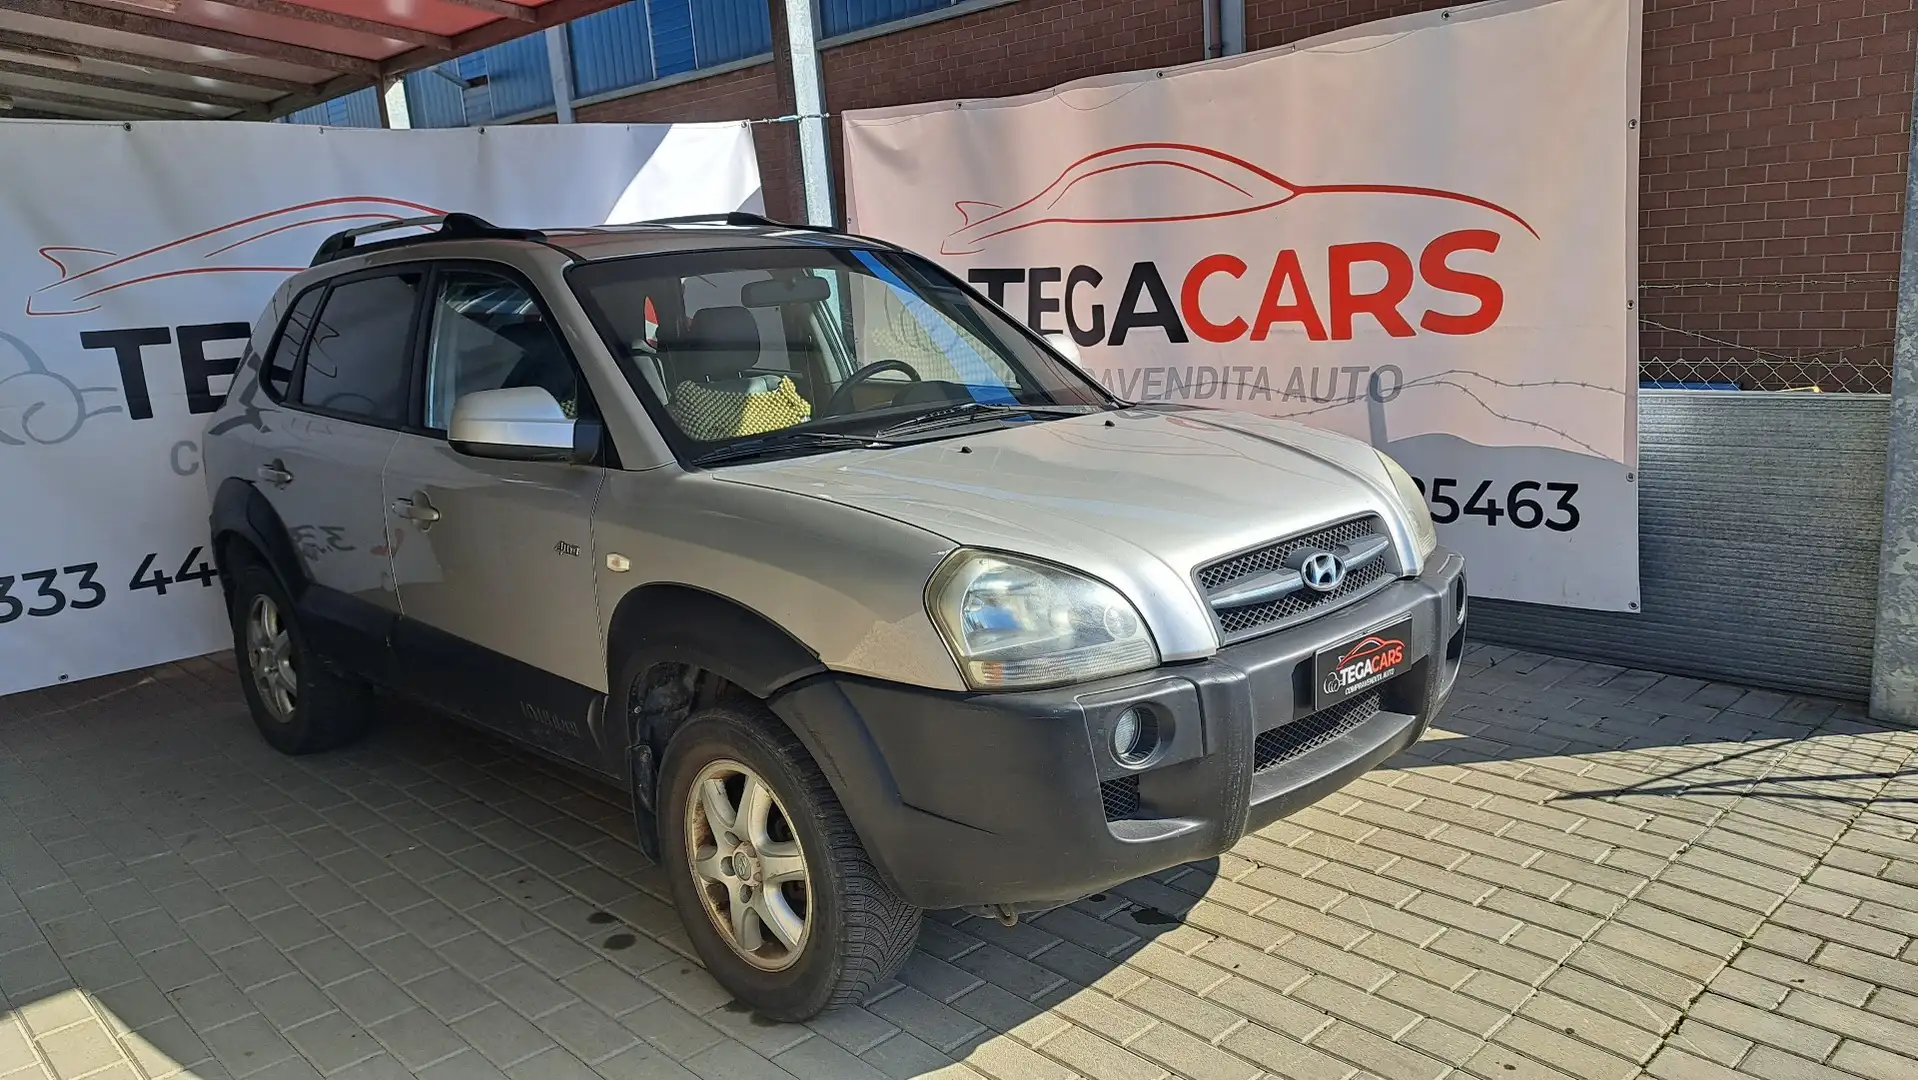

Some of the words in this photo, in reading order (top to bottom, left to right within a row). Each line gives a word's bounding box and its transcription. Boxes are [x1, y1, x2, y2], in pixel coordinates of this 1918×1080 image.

[968, 229, 1504, 347] TEGACARS
[1282, 364, 1404, 404] AUTO
[0, 562, 106, 623] 333
[1340, 646, 1403, 686] TEGACARS
